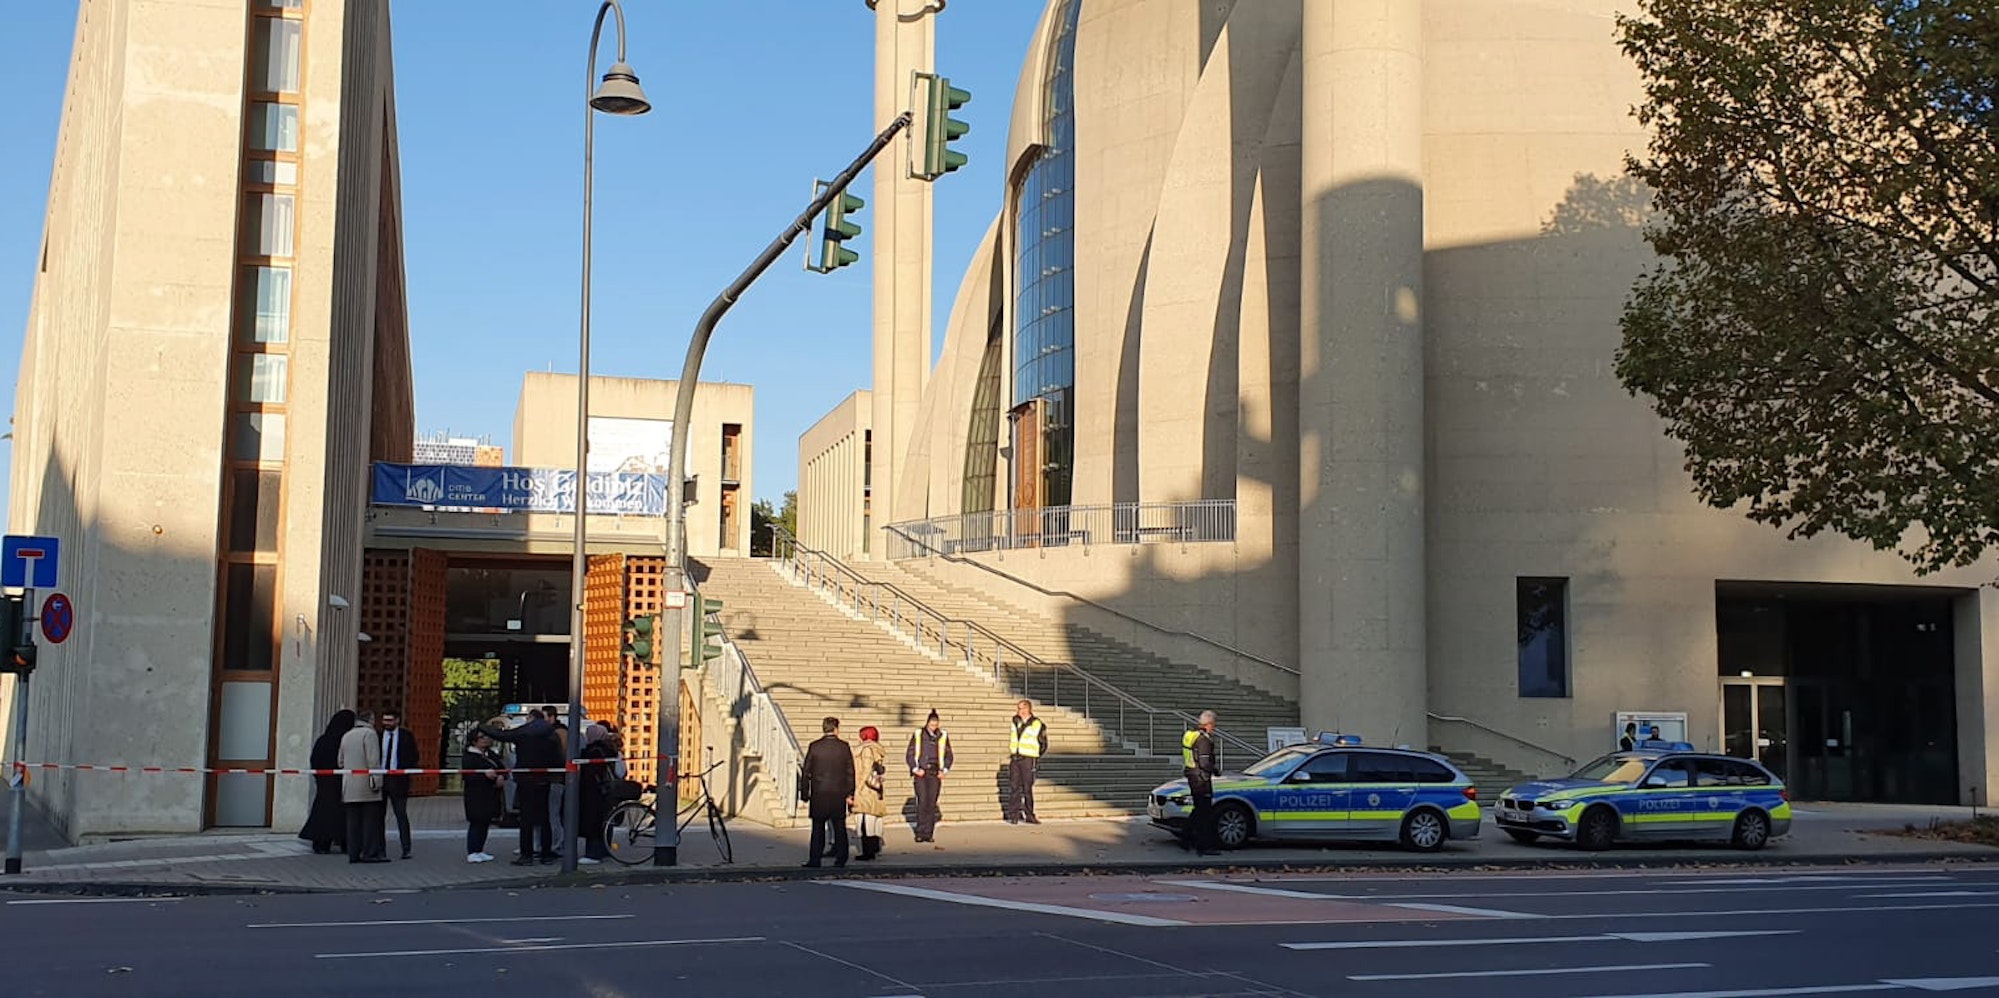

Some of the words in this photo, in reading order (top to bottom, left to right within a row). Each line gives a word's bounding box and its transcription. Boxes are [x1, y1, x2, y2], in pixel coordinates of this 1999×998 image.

[448, 492, 486, 502] CENTER
[1279, 795, 1331, 807] POLIZEI
[1639, 799, 1680, 810] POLIZEI
